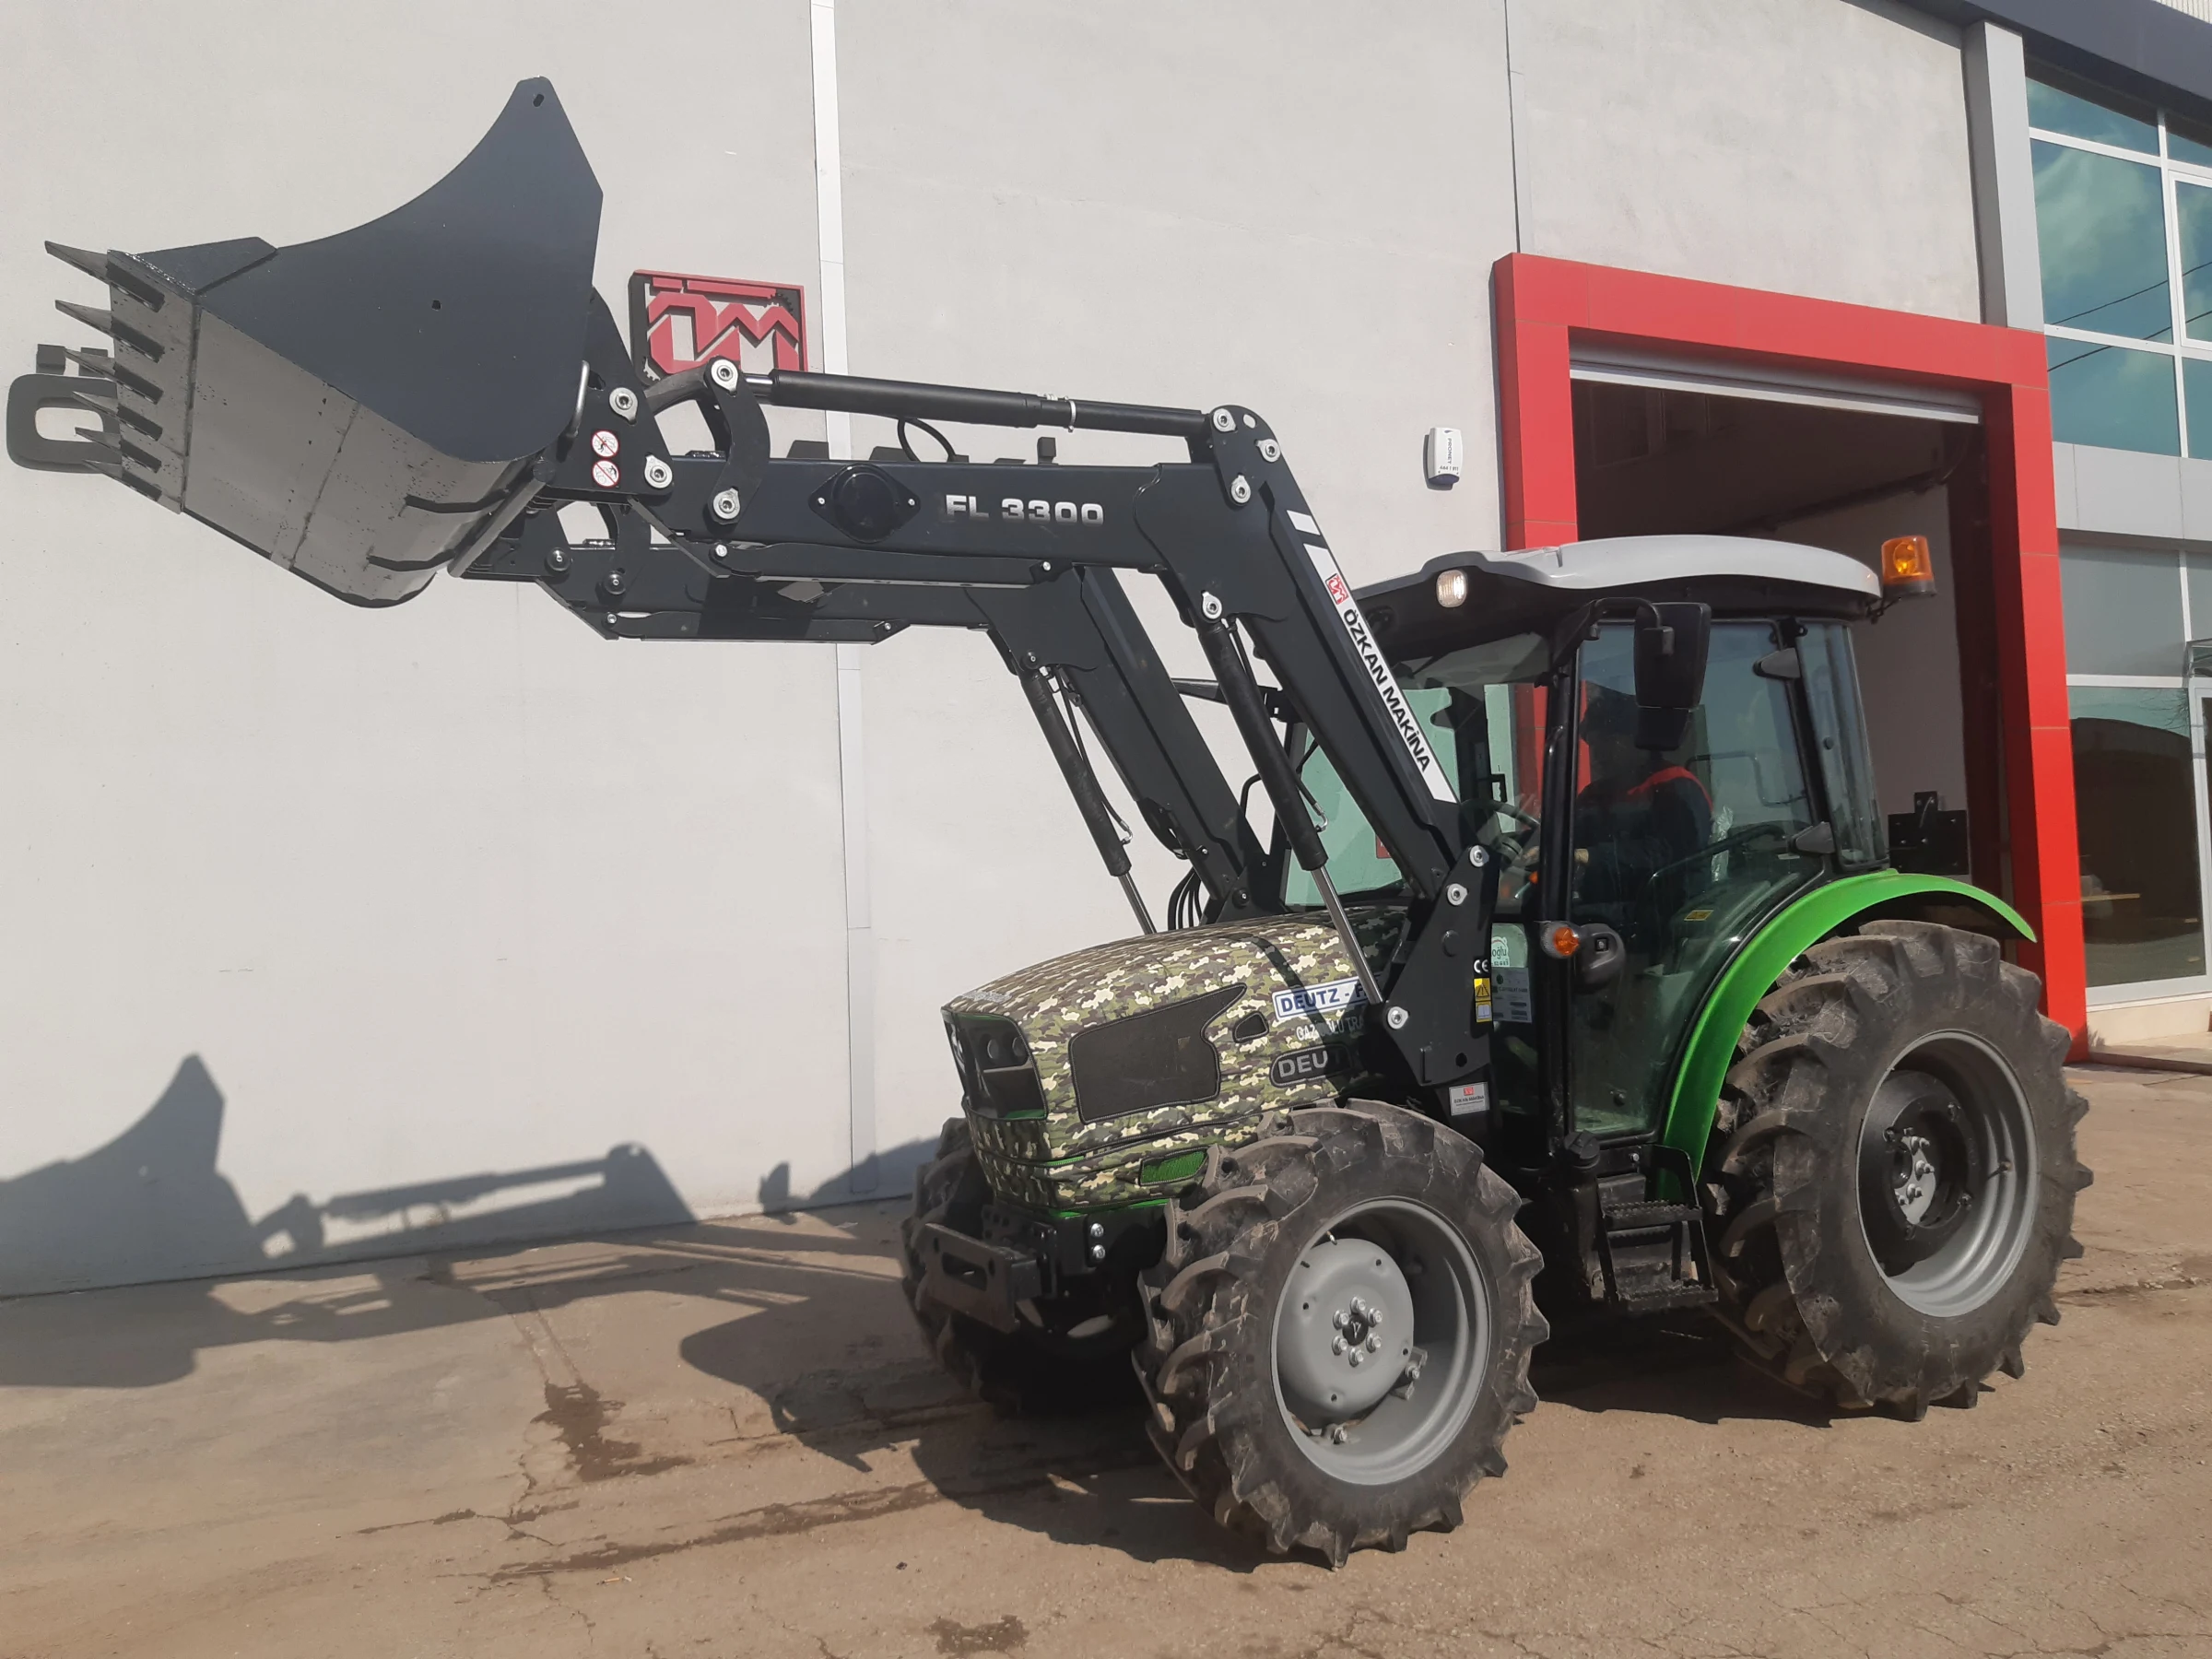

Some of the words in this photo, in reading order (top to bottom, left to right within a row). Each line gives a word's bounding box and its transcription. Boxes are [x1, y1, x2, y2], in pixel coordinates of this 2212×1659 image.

[946, 494, 990, 518] FL
[1001, 498, 1104, 526] 3300
[1343, 608, 1388, 685] ÖZKAN
[1382, 686, 1430, 772] MAKİNA
[1280, 987, 1340, 1013] DEUTZ
